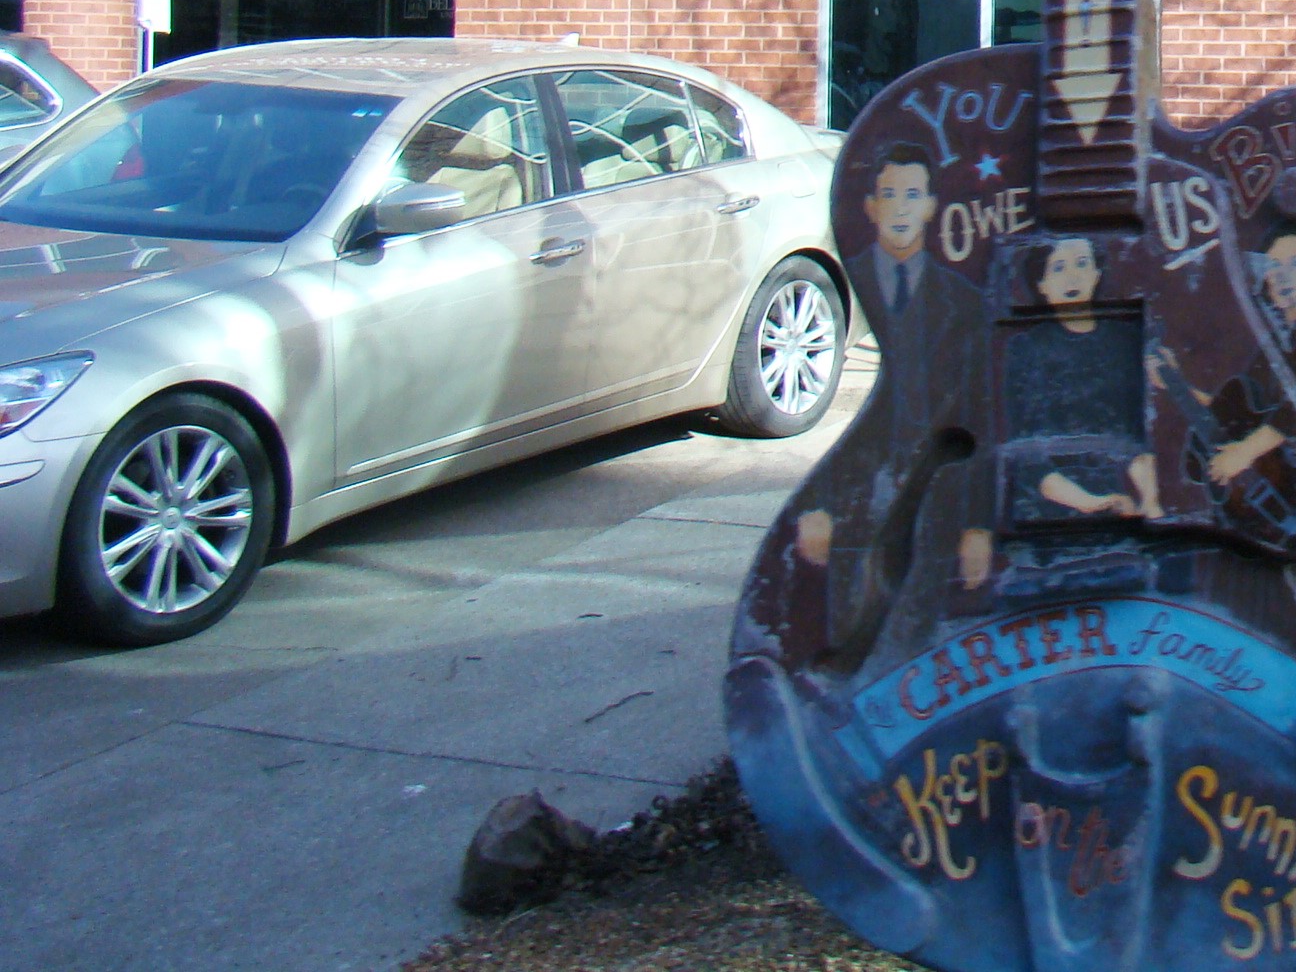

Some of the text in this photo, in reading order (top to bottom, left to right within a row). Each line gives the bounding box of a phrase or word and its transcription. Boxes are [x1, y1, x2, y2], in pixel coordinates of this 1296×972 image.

[902, 82, 1034, 168] YOU
[939, 177, 1219, 263] OWE US
[900, 608, 1265, 720] CARTER family
